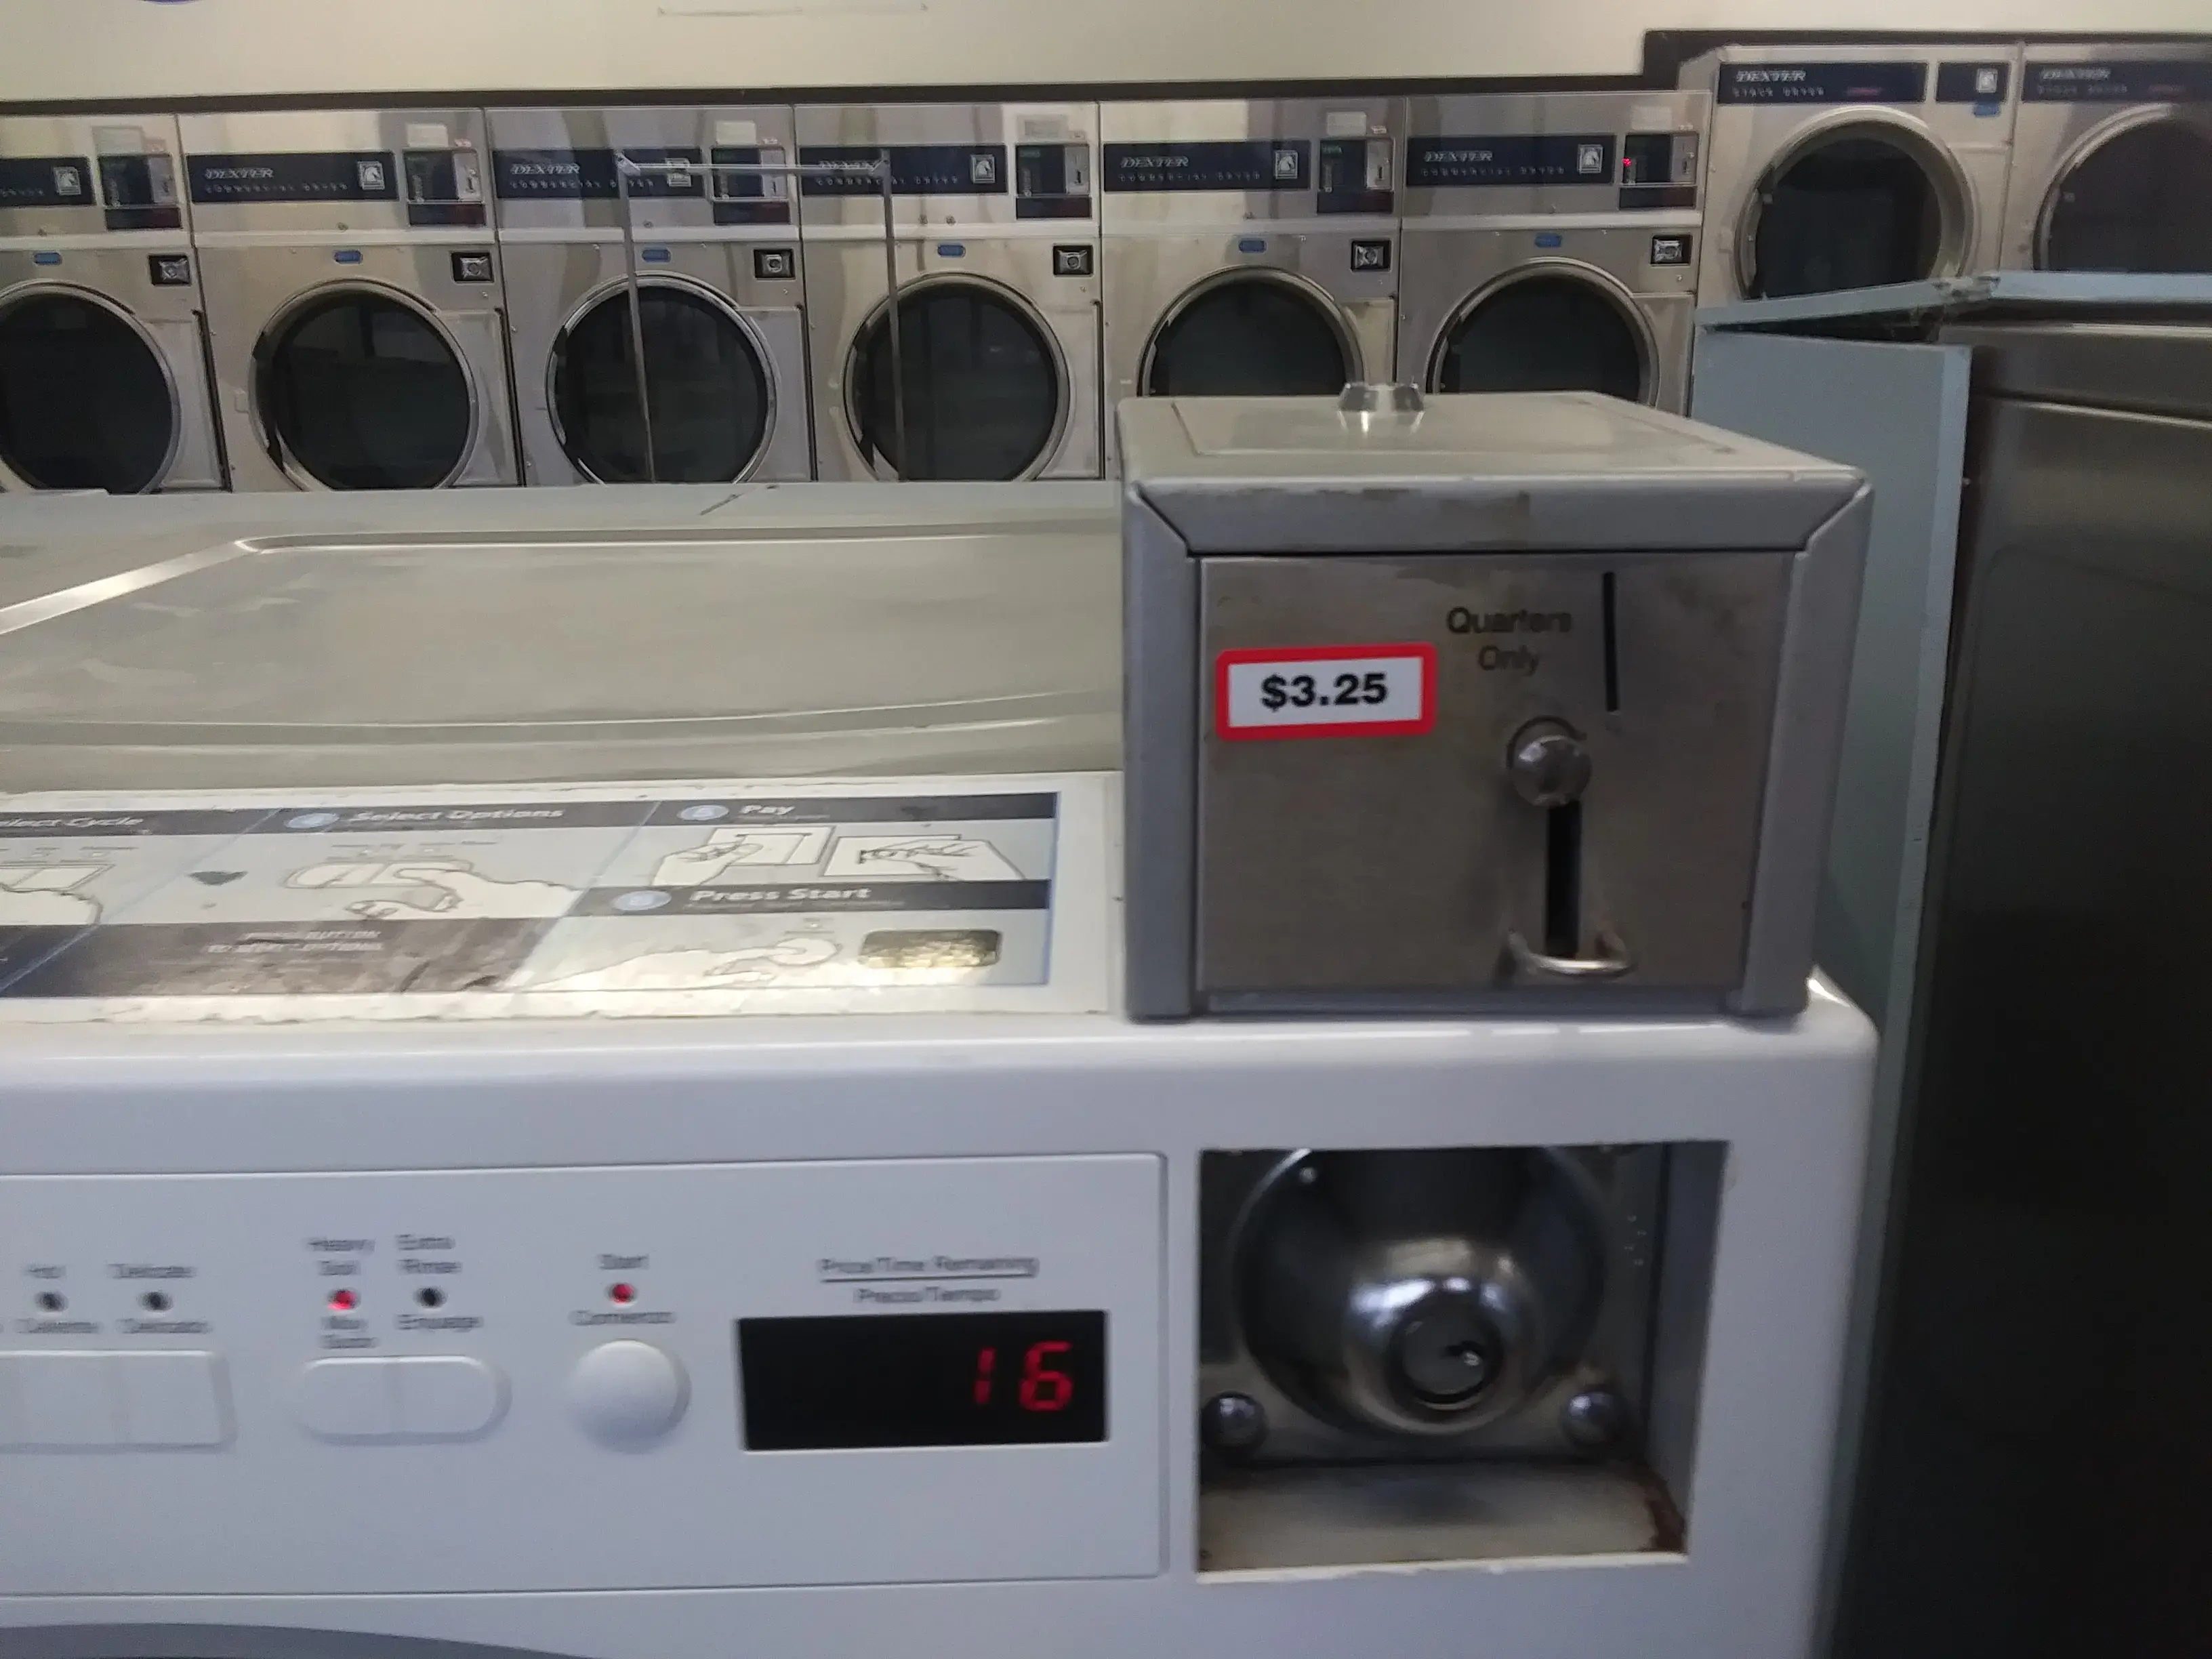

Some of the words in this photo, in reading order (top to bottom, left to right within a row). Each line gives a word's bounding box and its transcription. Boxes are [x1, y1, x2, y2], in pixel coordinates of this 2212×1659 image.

[511, 163, 581, 176] DEXTER
[1120, 156, 1189, 169] DEXTER
[1446, 607, 1572, 634] Quarters
[1479, 646, 1539, 676] Only
[1261, 672, 1387, 712] $3.25
[348, 811, 441, 823] Select
[446, 808, 565, 820] Options
[741, 804, 795, 817] Pay
[692, 890, 779, 902] Press
[787, 886, 872, 901] Start
[974, 1341, 1073, 1411] 16
